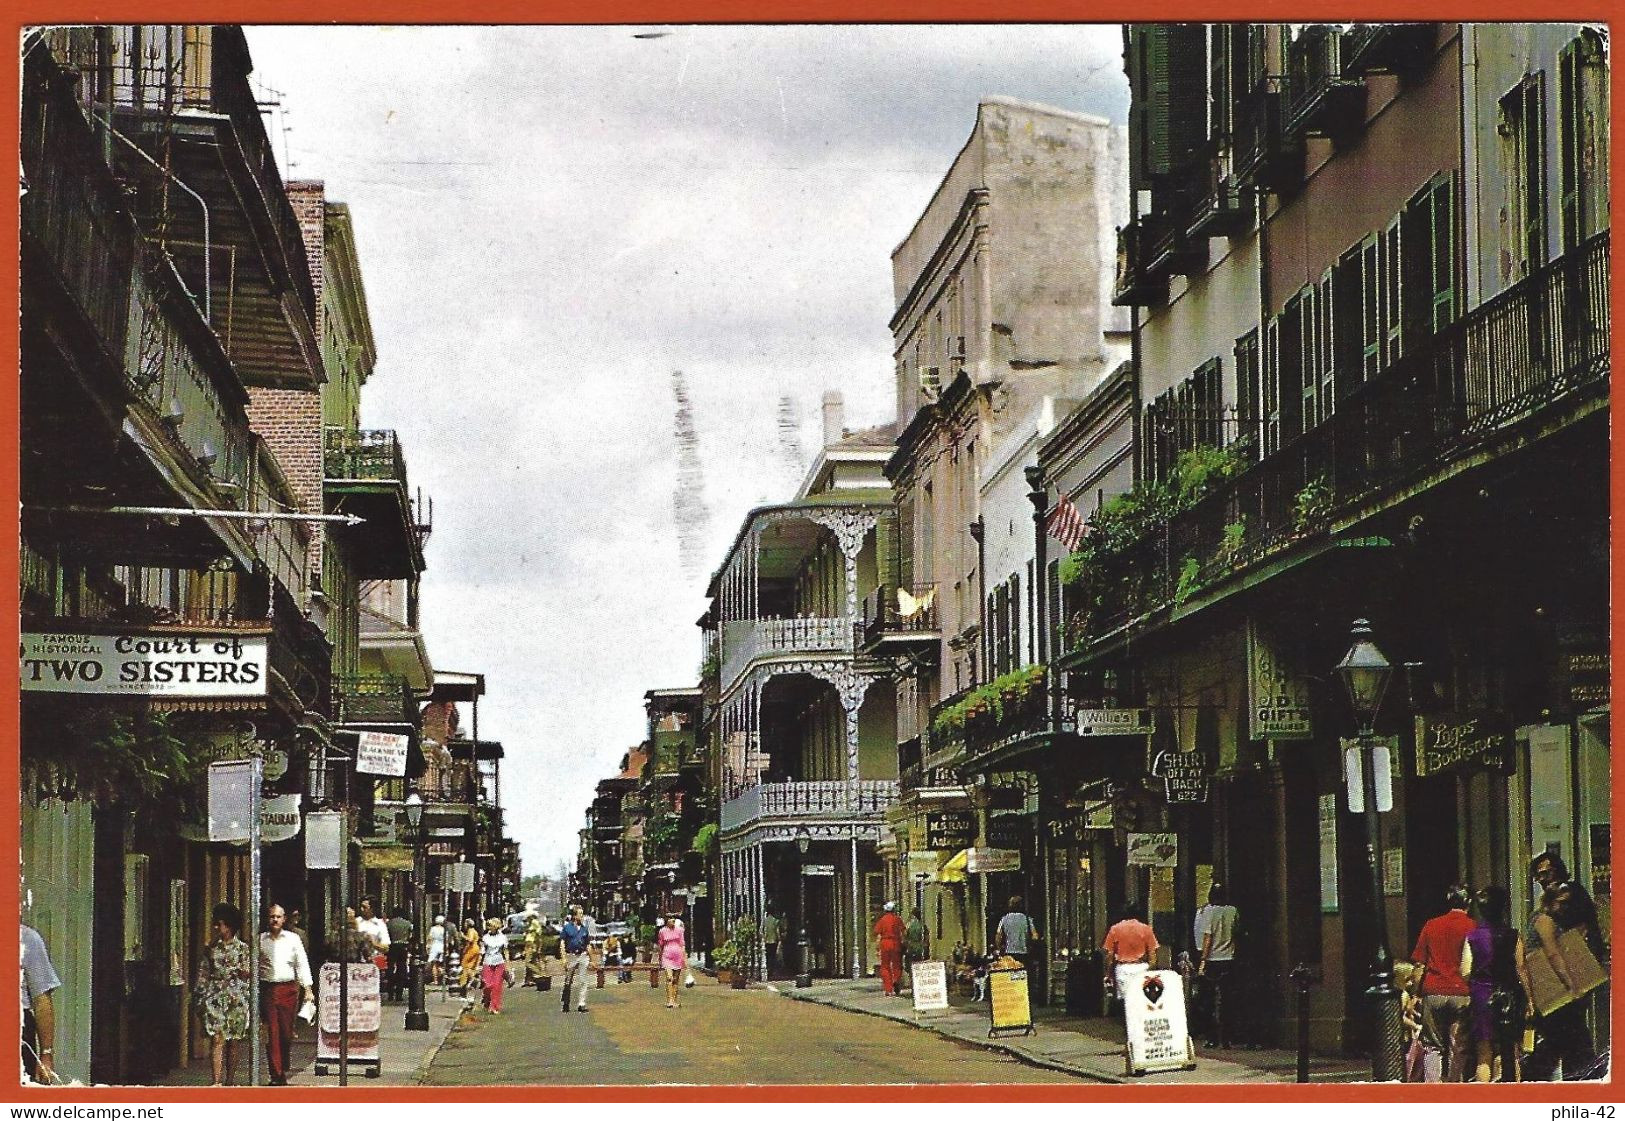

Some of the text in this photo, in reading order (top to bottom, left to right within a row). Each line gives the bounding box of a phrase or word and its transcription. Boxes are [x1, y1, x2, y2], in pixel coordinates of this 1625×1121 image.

[43, 635, 91, 644] FAMOUS
[32, 644, 101, 654] HISTORICAL
[114, 637, 243, 660] Court of
[24, 660, 260, 684] TWO SISTERS
[1163, 753, 1207, 769] SHIRT
[1172, 779, 1202, 790] BACK
